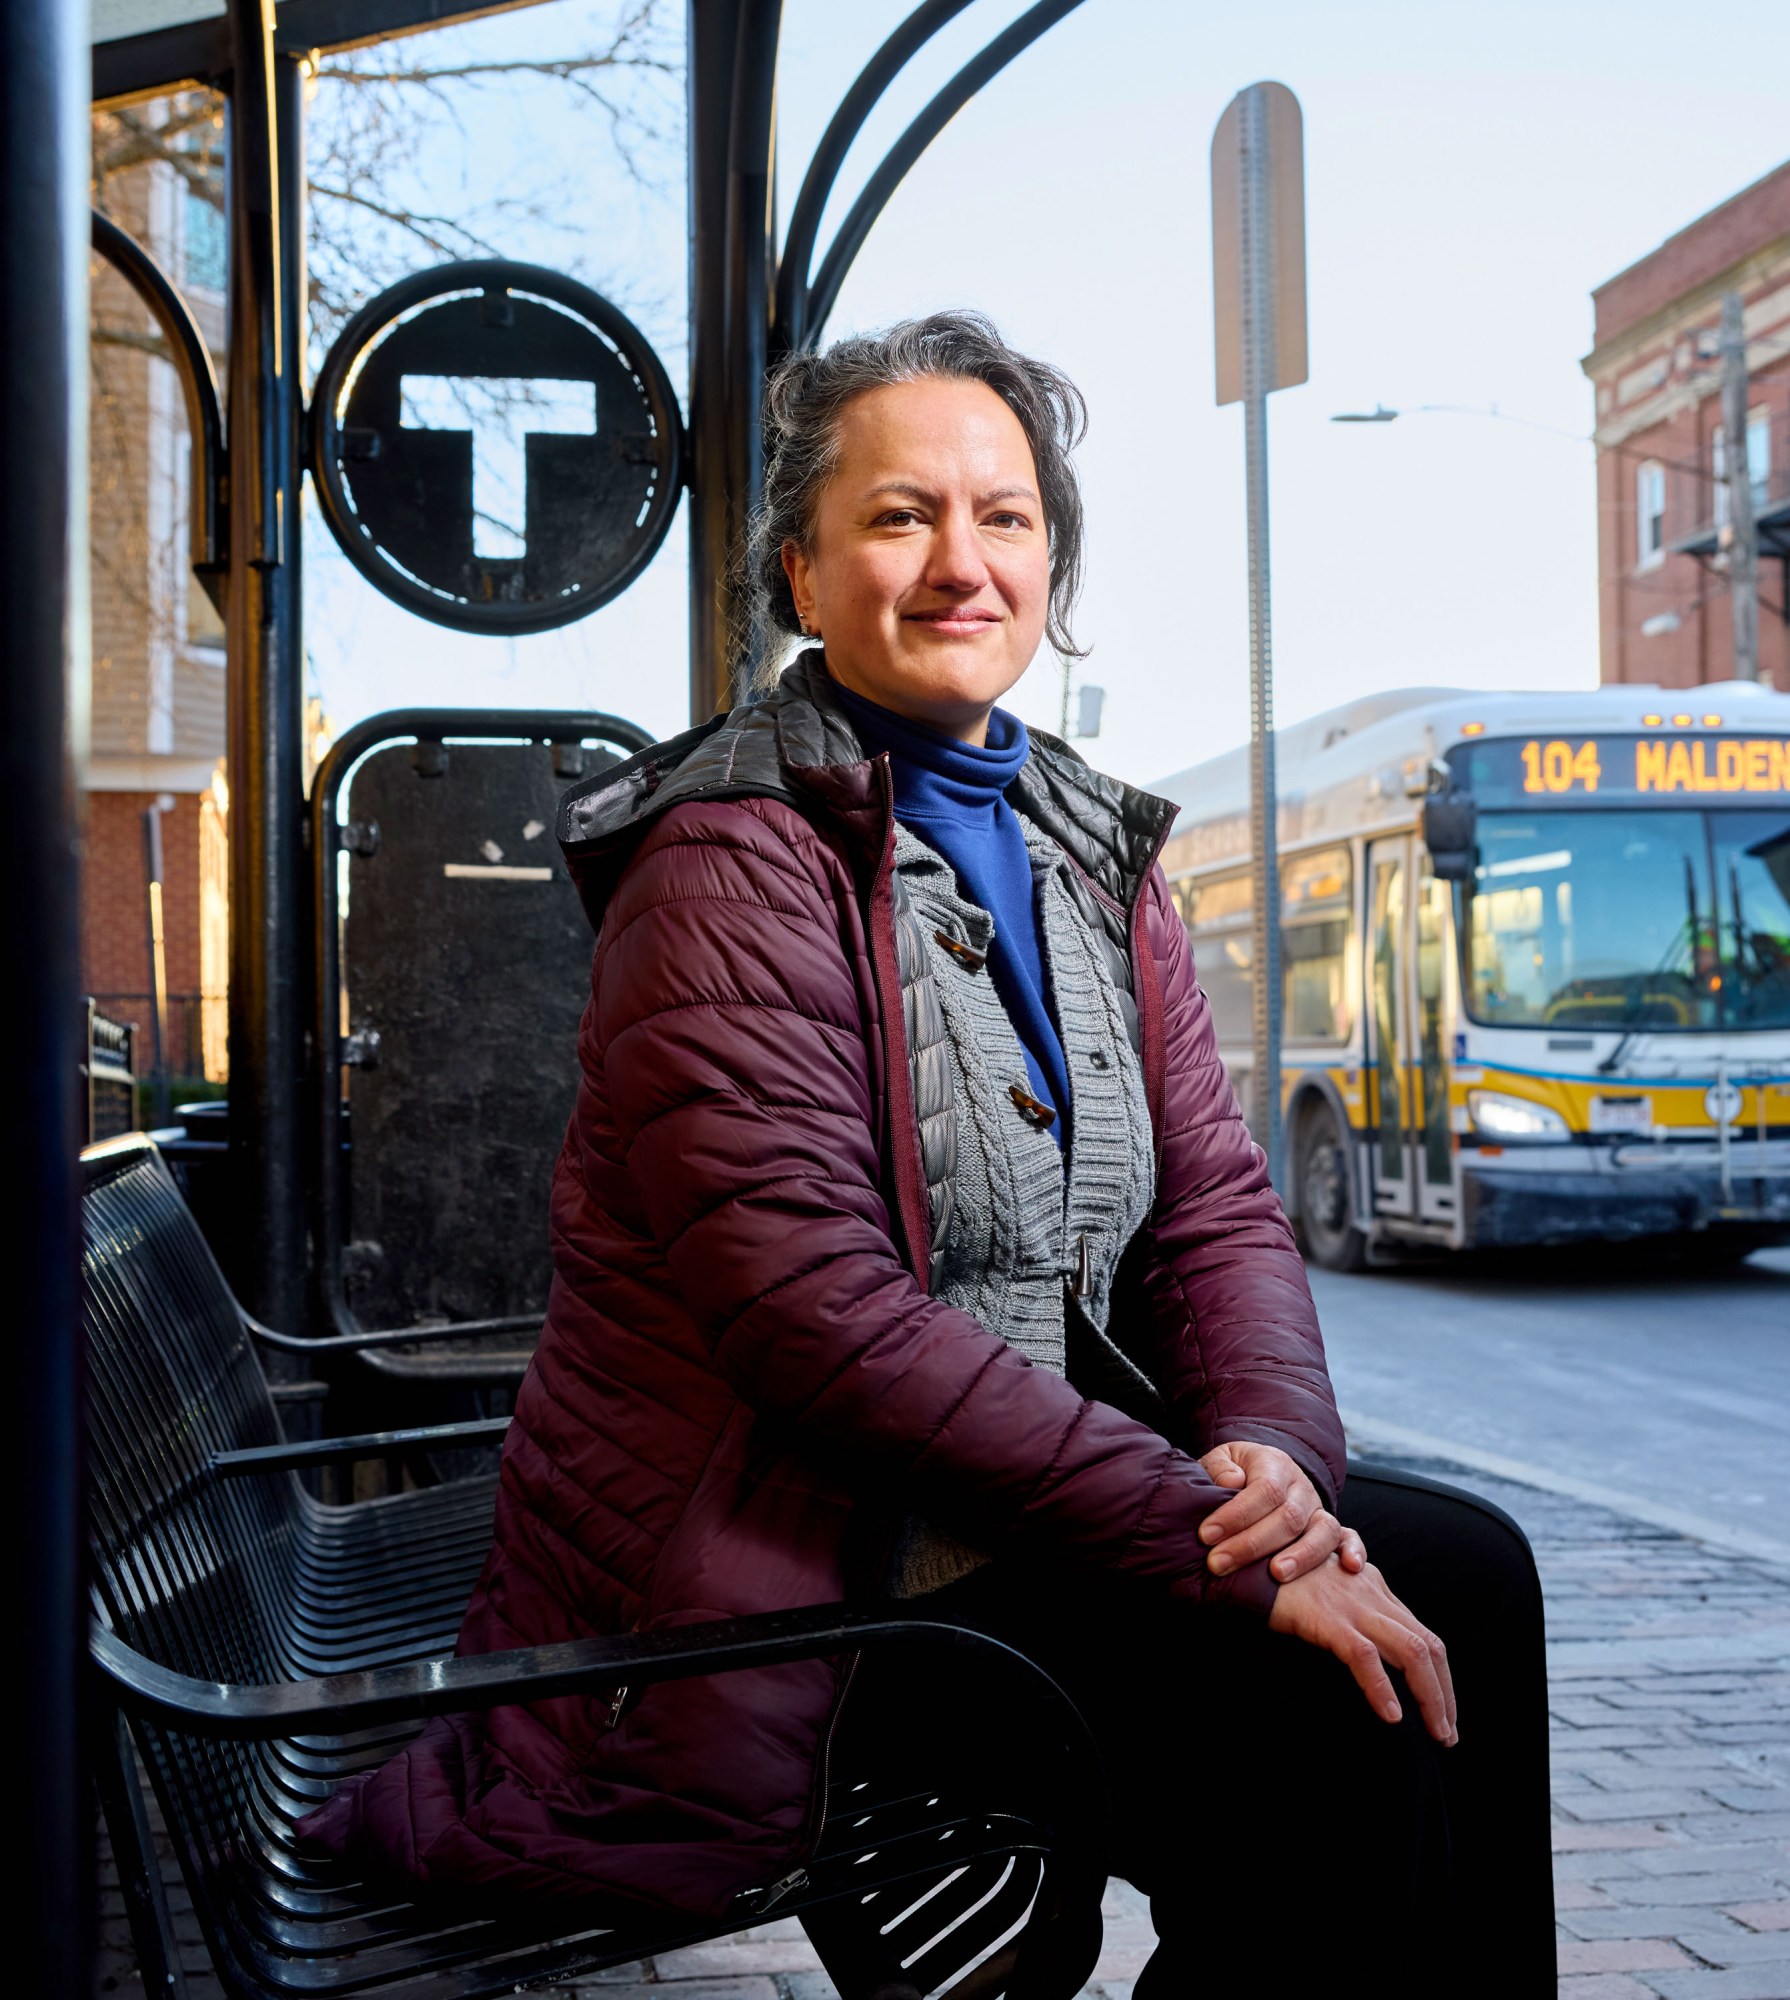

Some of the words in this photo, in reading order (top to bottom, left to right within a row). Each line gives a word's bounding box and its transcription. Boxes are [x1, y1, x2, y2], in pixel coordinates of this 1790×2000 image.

[400, 374, 597, 559] T
[1521, 741, 1601, 792] 104
[1636, 741, 1790, 792] MALDEN
